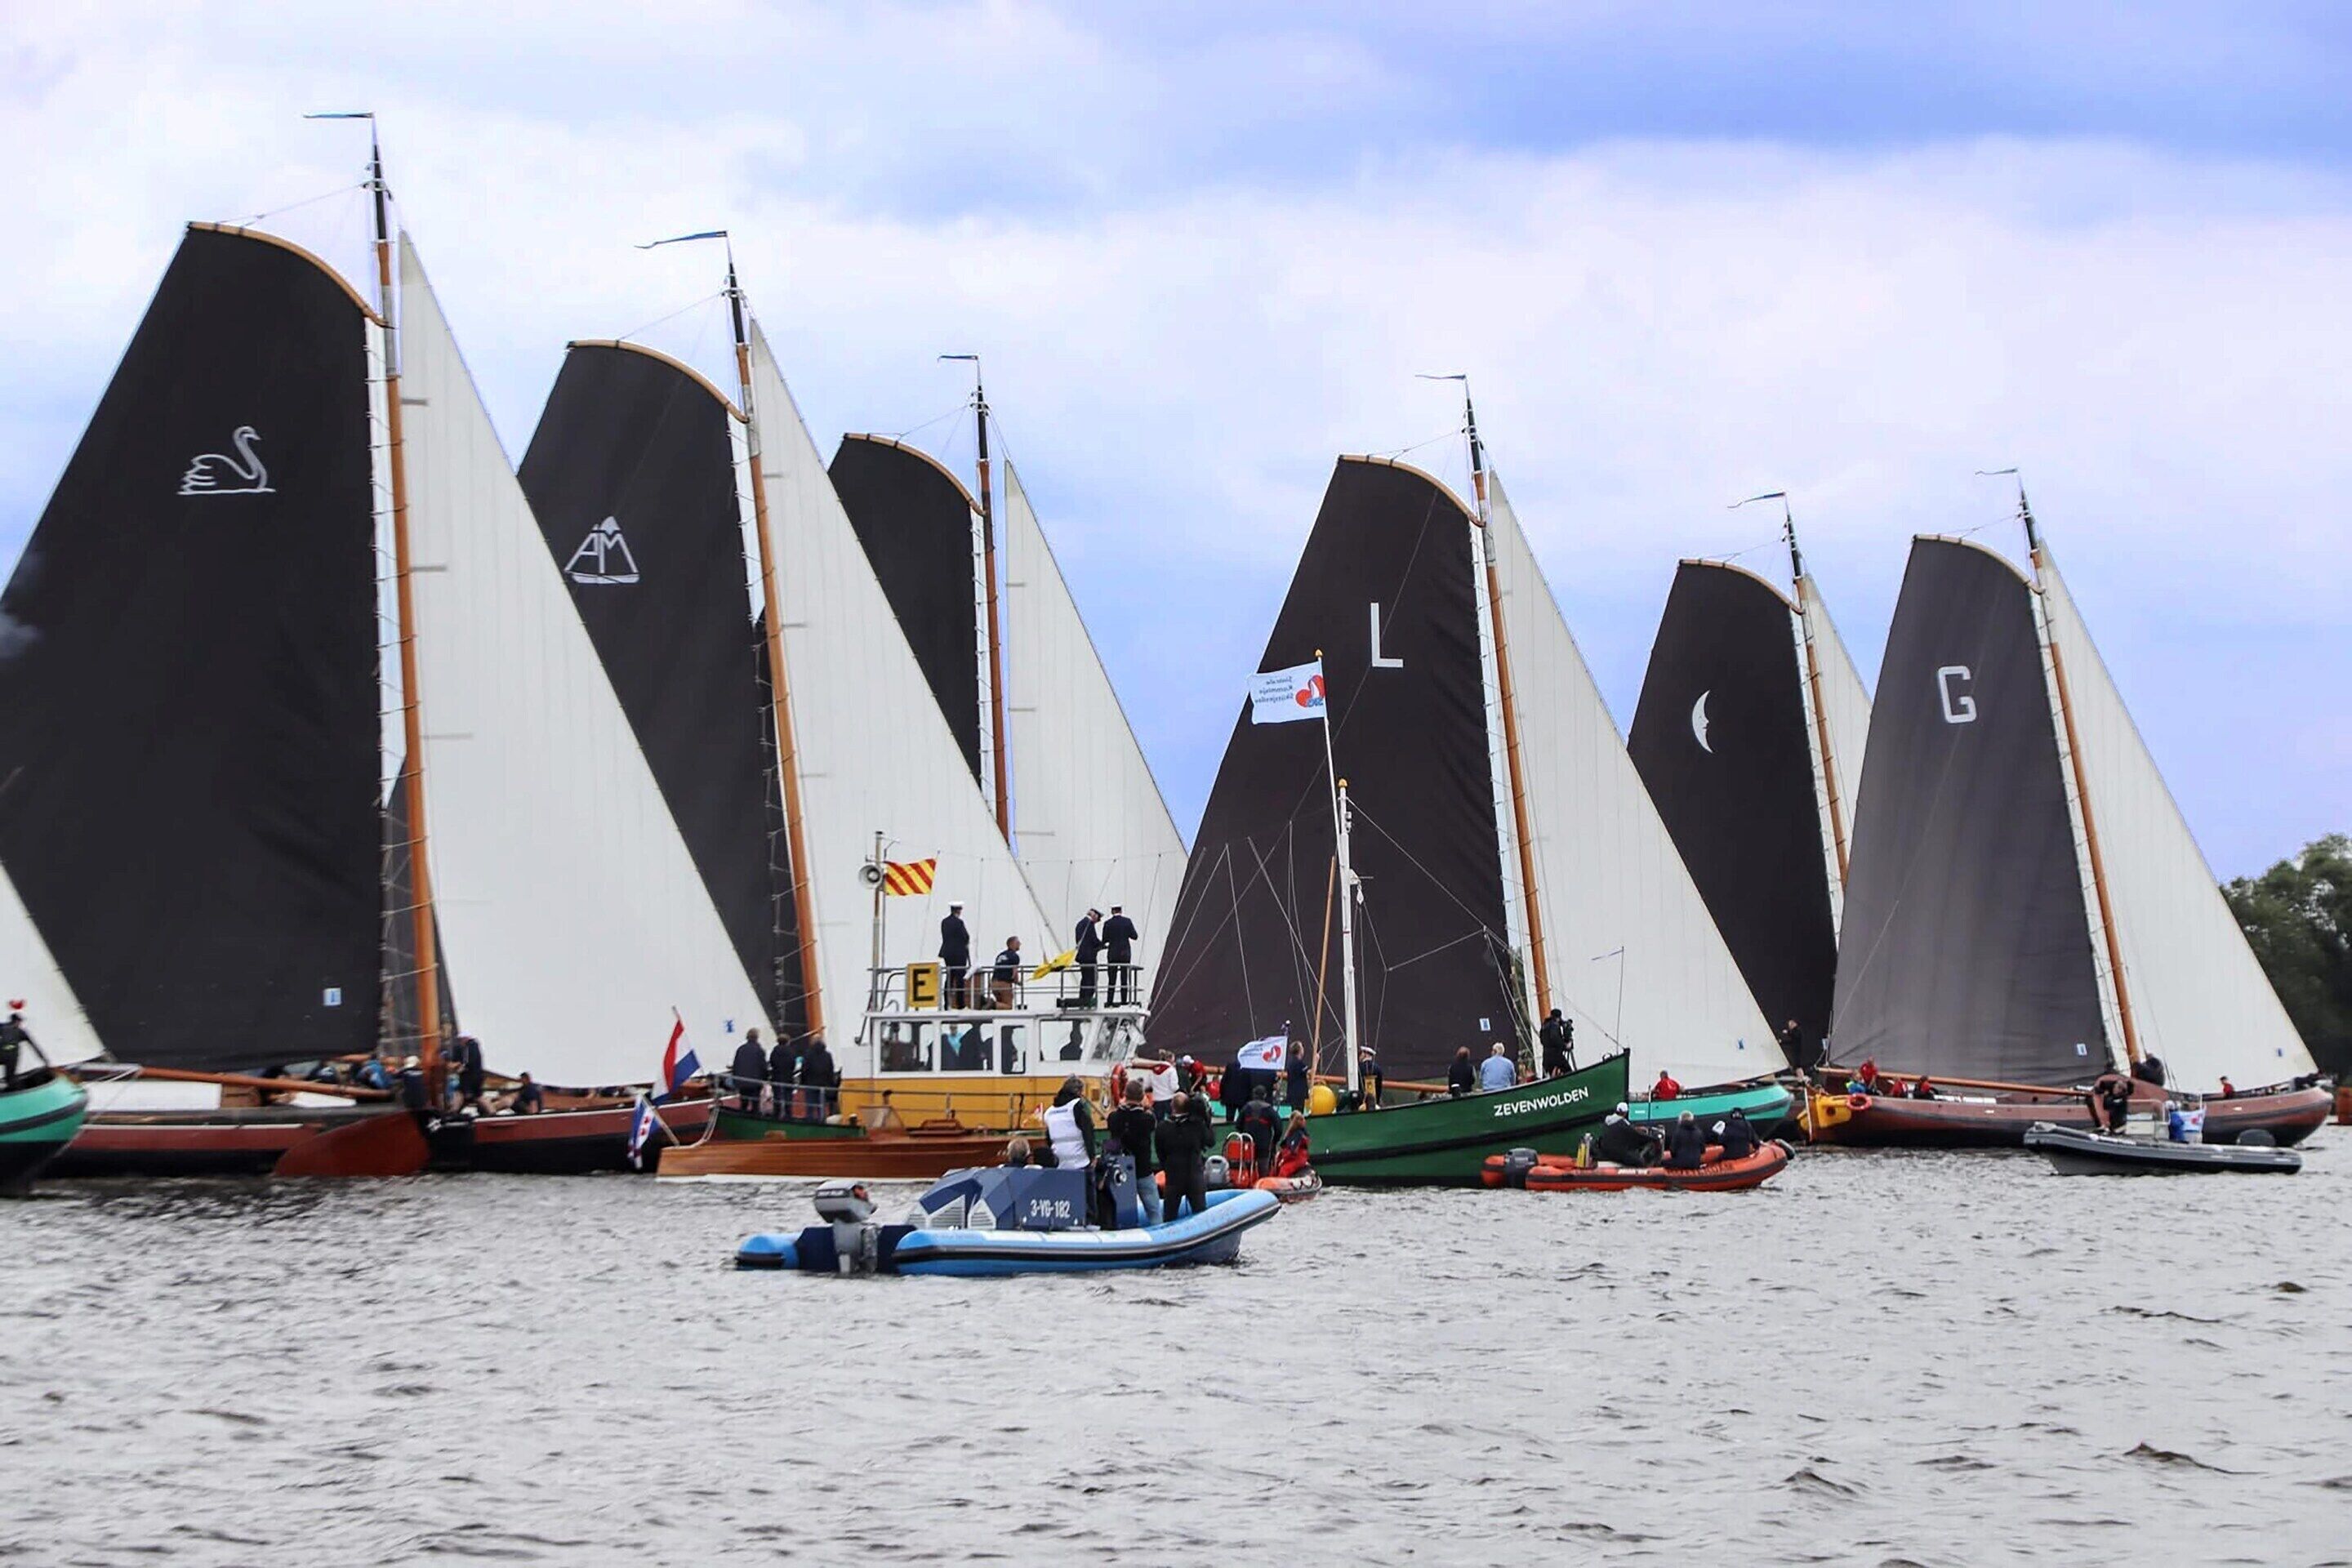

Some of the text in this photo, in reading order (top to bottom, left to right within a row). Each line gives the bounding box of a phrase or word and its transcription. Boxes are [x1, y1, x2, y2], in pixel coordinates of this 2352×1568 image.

[1370, 602, 1404, 668] L
[1938, 665, 1976, 724] G
[911, 968, 935, 1002] E
[1493, 1085, 1589, 1117] ZEVENWOLDEN
